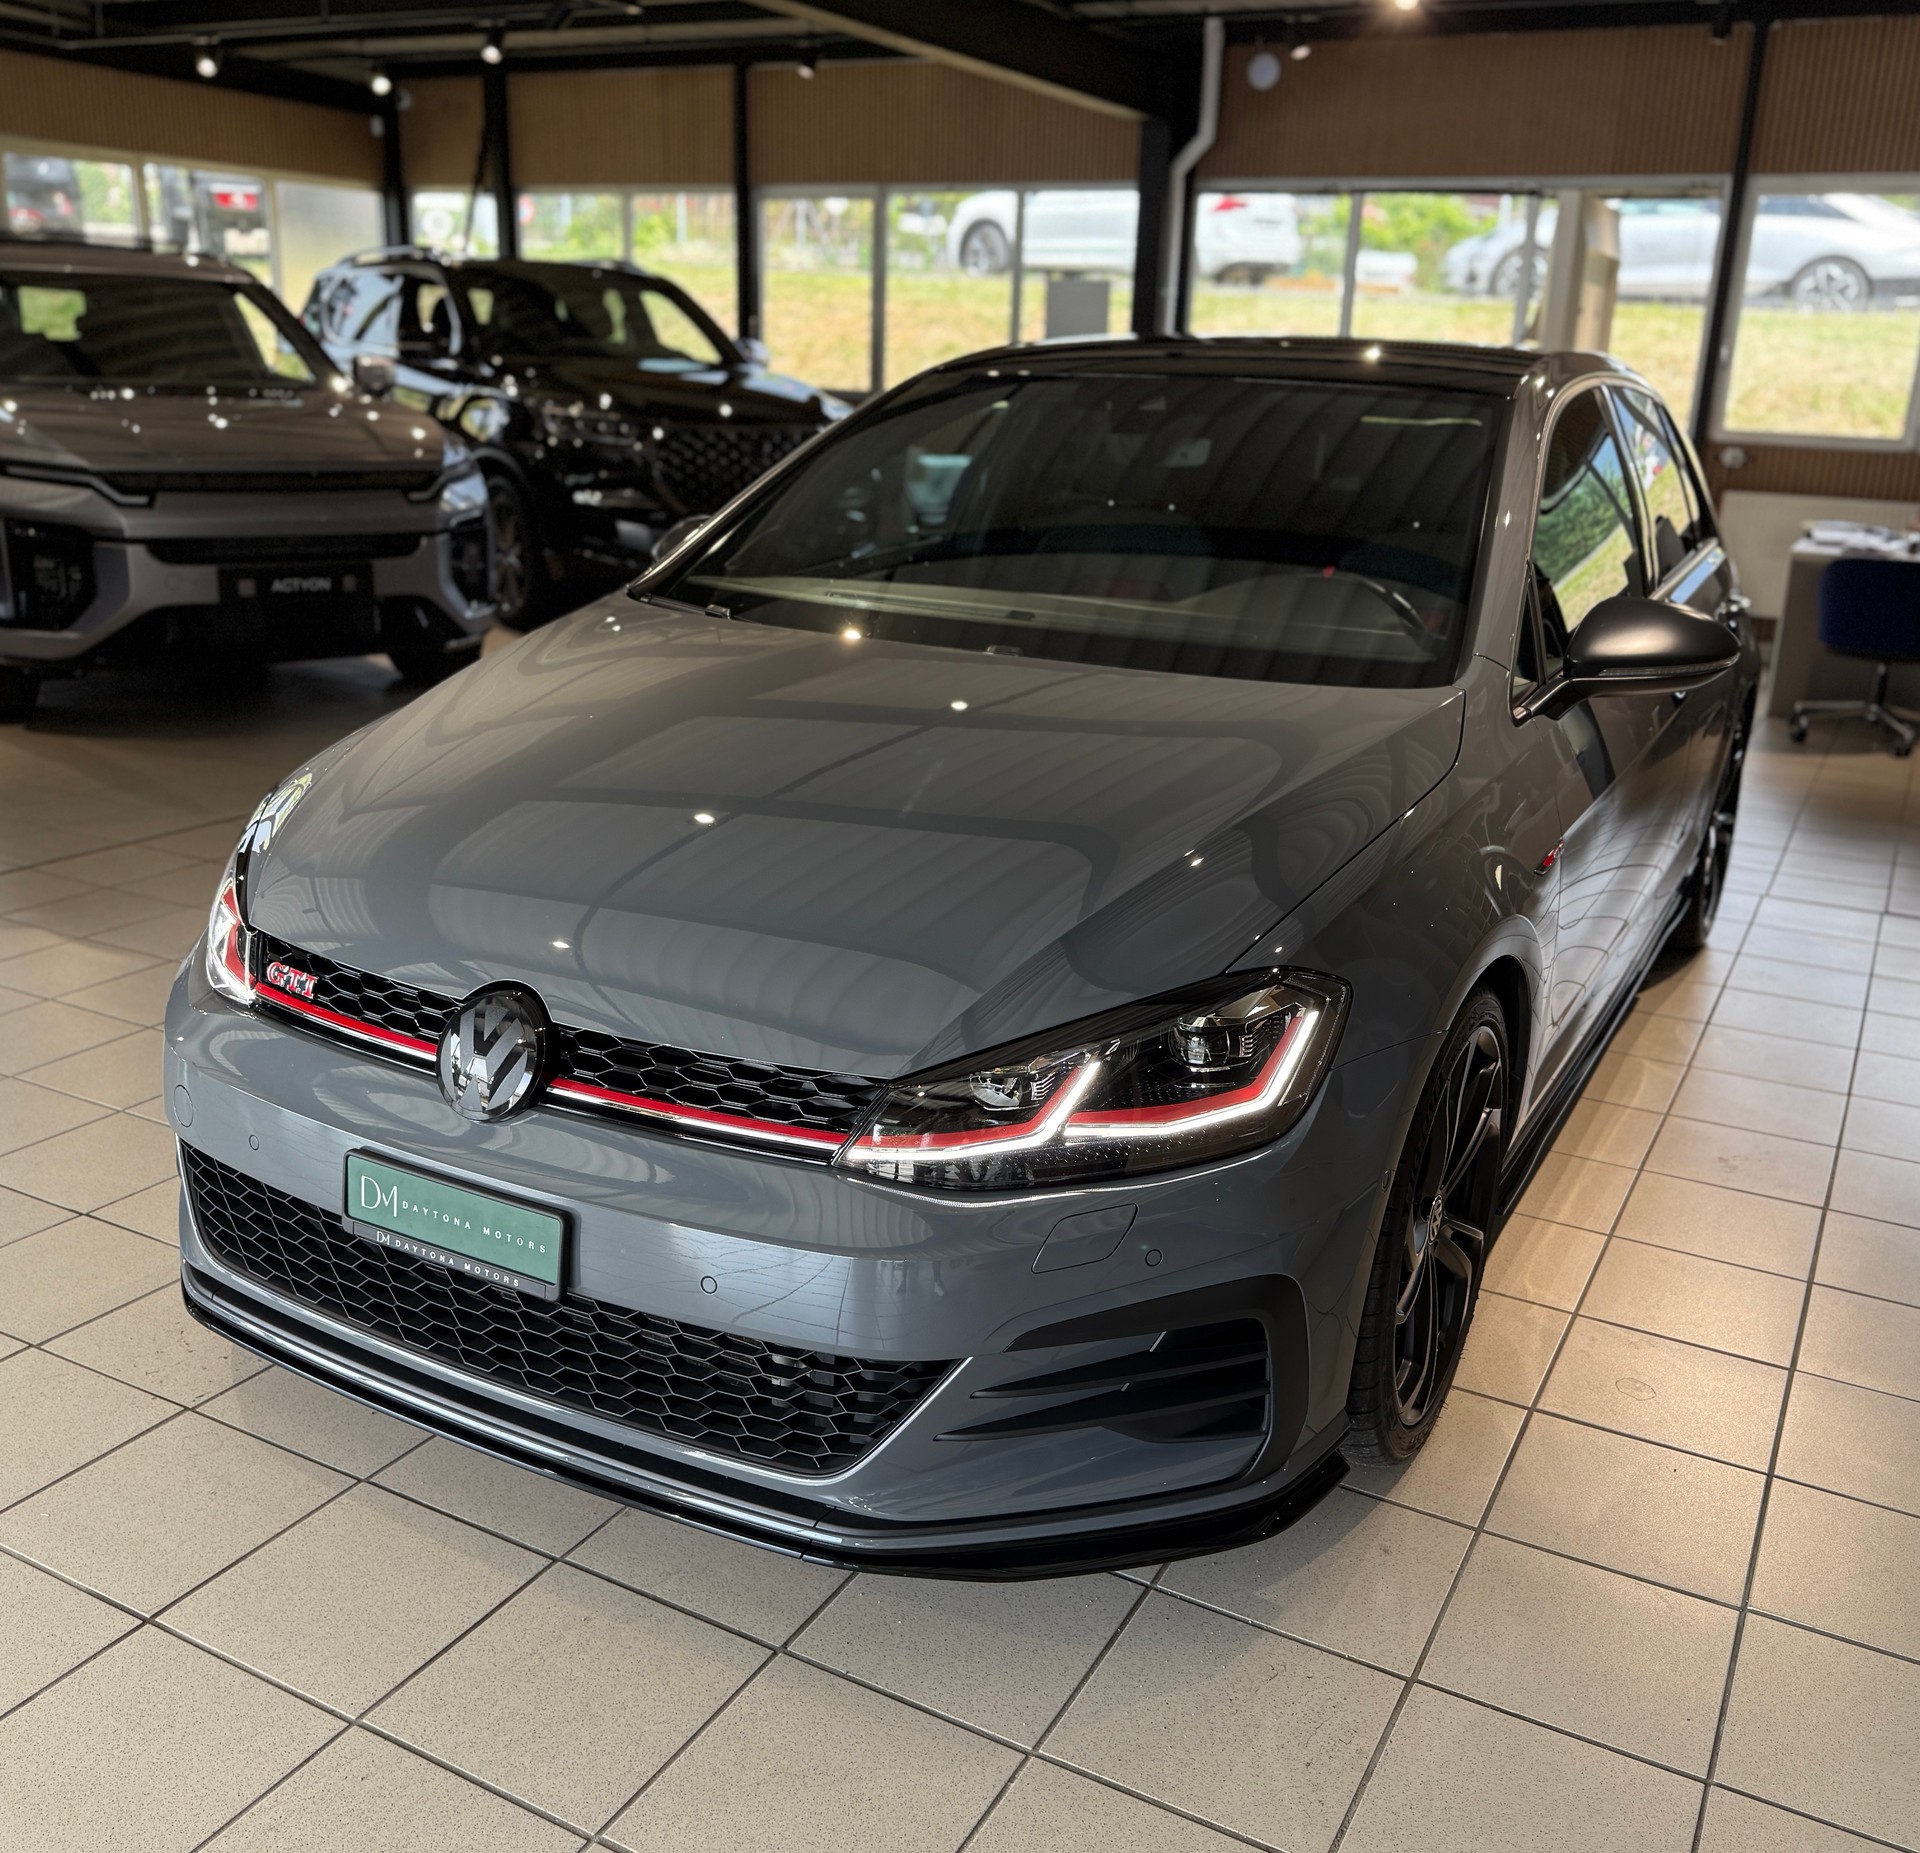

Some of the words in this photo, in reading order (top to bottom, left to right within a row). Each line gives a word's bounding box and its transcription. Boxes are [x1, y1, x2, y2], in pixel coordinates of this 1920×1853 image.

[267, 961, 319, 999] GTI
[402, 1200, 471, 1230] DAYTONA
[483, 1226, 546, 1254] MOTORS
[395, 1239, 455, 1265] DAYTONA
[464, 1262, 520, 1287] MOTORS
